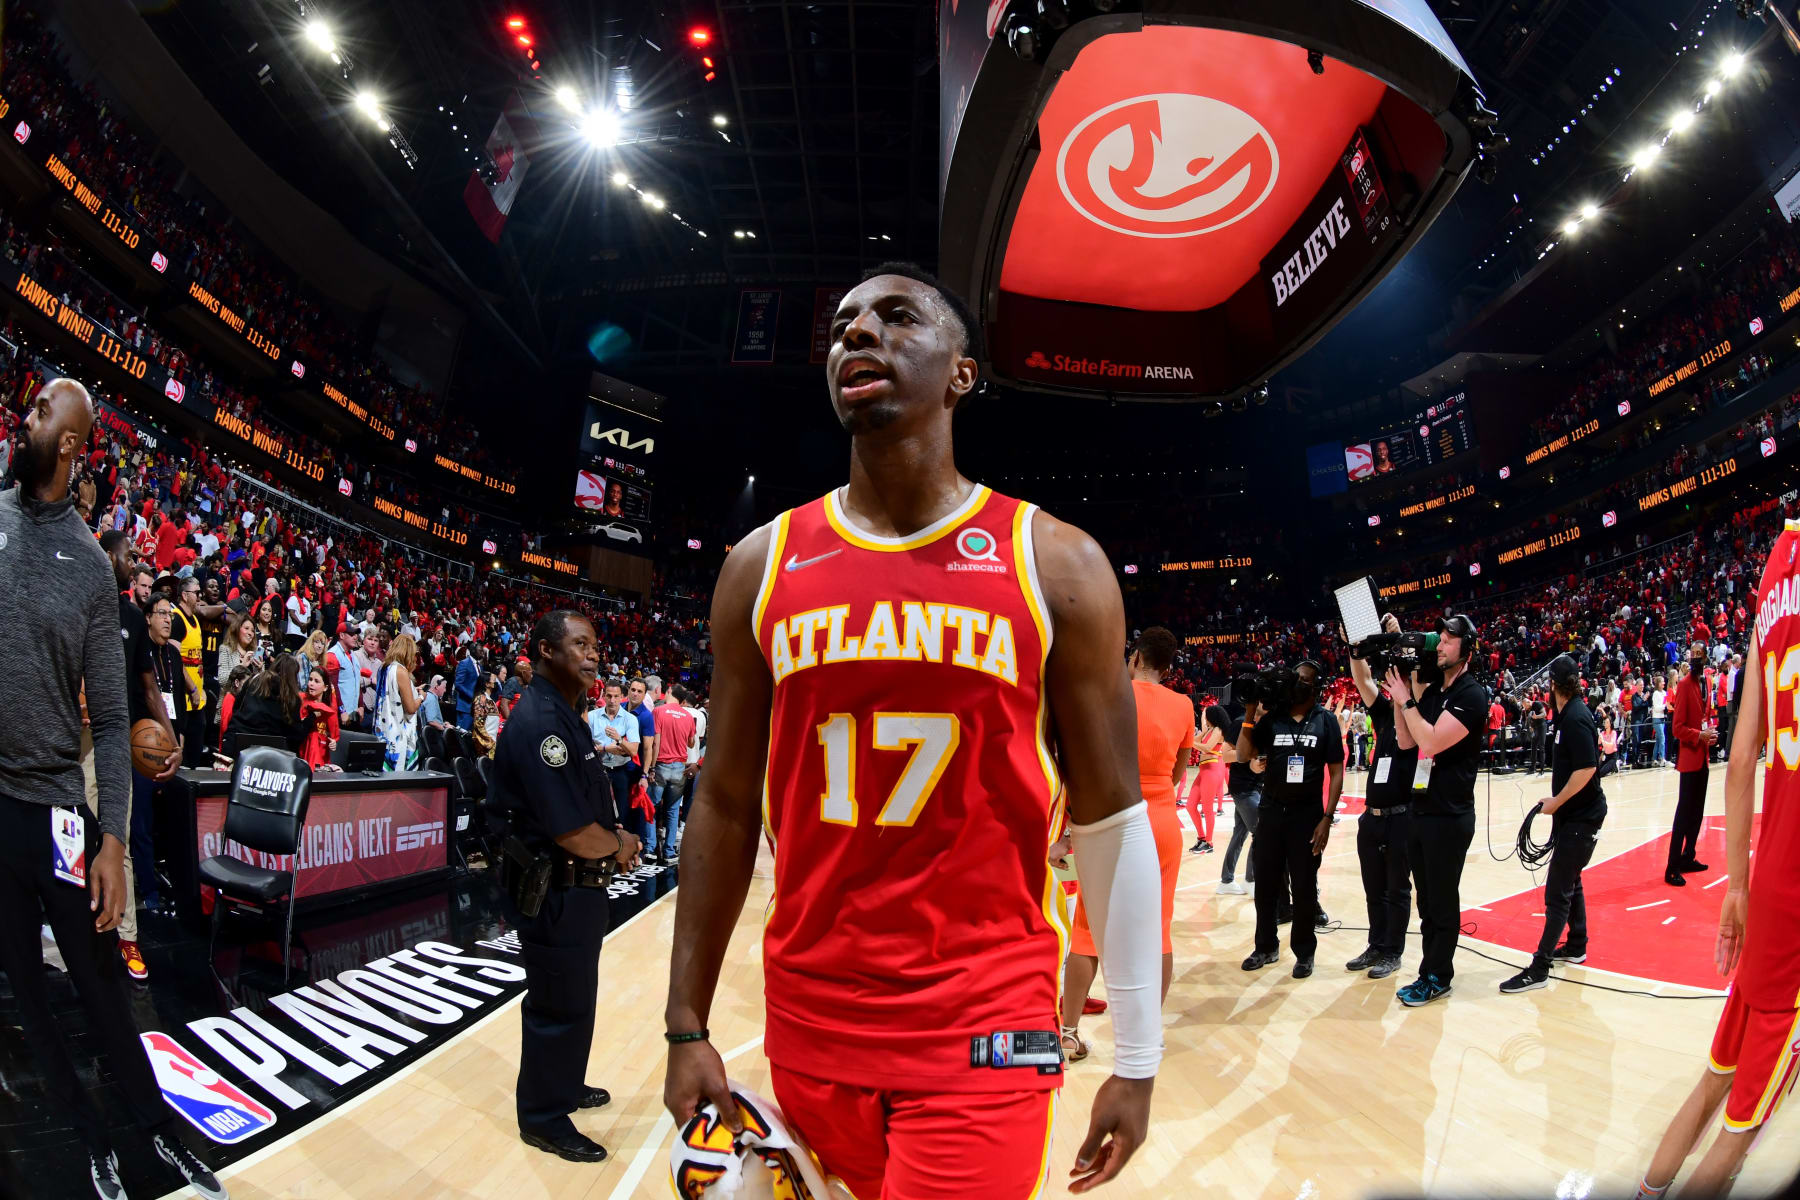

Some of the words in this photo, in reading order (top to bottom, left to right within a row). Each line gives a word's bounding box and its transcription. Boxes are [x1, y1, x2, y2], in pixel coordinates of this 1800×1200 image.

[1357, 168, 1367, 183] 111
[1361, 178, 1371, 194] 110
[46, 153, 77, 191] HAWKS
[74, 181, 102, 215] WIN!!!
[101, 208, 140, 249] 111-110
[1271, 196, 1350, 307] BELIEVE
[16, 273, 59, 317] HAWKS
[57, 304, 95, 344] WIN!!!
[97, 334, 147, 379] 111-110
[188, 281, 221, 314] HAWKS
[219, 304, 245, 334] WIN!!!
[247, 327, 280, 360] 111-110
[1144, 365, 1194, 380] ARENA
[1648, 374, 1676, 397] HAWKS
[1675, 360, 1699, 382] WIN!!!
[1700, 340, 1732, 367] 111-110
[323, 382, 348, 408] HAWKS
[348, 400, 368, 422] WIN!!!
[369, 416, 395, 441] 111-110
[137, 429, 158, 449] RENA
[214, 407, 252, 441] HAWKS
[252, 429, 283, 459] WIN!!!
[286, 449, 325, 482] 111-110
[1525, 446, 1549, 465] HAWKS
[1548, 435, 1569, 453] WIN!!!
[1571, 419, 1599, 442] 111-110
[435, 453, 460, 473] HAWKS
[460, 465, 482, 482] WIN!!!
[485, 476, 516, 494] 111-110
[1311, 465, 1337, 476] CHASE
[1638, 487, 1670, 511] HAWKS
[1669, 475, 1697, 499] WIN!!!
[1701, 458, 1737, 486] 111-110
[374, 495, 403, 519] HAWKS
[404, 509, 429, 531] WIN!!!
[432, 522, 468, 545] 111-110
[1400, 503, 1425, 517] HAWKS
[1425, 496, 1446, 510] WIN!!!
[1448, 485, 1475, 503] 111-110
[522, 551, 552, 569] HAWKS
[554, 559, 579, 576] WIN!!!
[1161, 562, 1189, 571] HAWKS
[1190, 560, 1215, 570] WIN!!!
[1219, 557, 1252, 568] 111-110
[1498, 547, 1524, 564] HAWKS
[1523, 538, 1546, 556] WIN!!!
[1549, 526, 1580, 547] 111-110
[947, 561, 1007, 573] sharecare
[1379, 586, 1397, 597] WKS
[1398, 581, 1420, 594] WIN!!!
[1423, 573, 1451, 589] 111-110
[207, 636, 217, 652] 11
[771, 600, 1019, 687] ATLANTA
[1764, 643, 1800, 772] 13
[1273, 733, 1318, 748] ESPN
[249, 767, 296, 793] PLAYOFFS
[816, 711, 960, 827] 17
[359, 816, 393, 860] NEXT
[396, 821, 444, 852] ESPN
[186, 940, 528, 1110] PLAYOFFS
[202, 1109, 250, 1137] NBA
